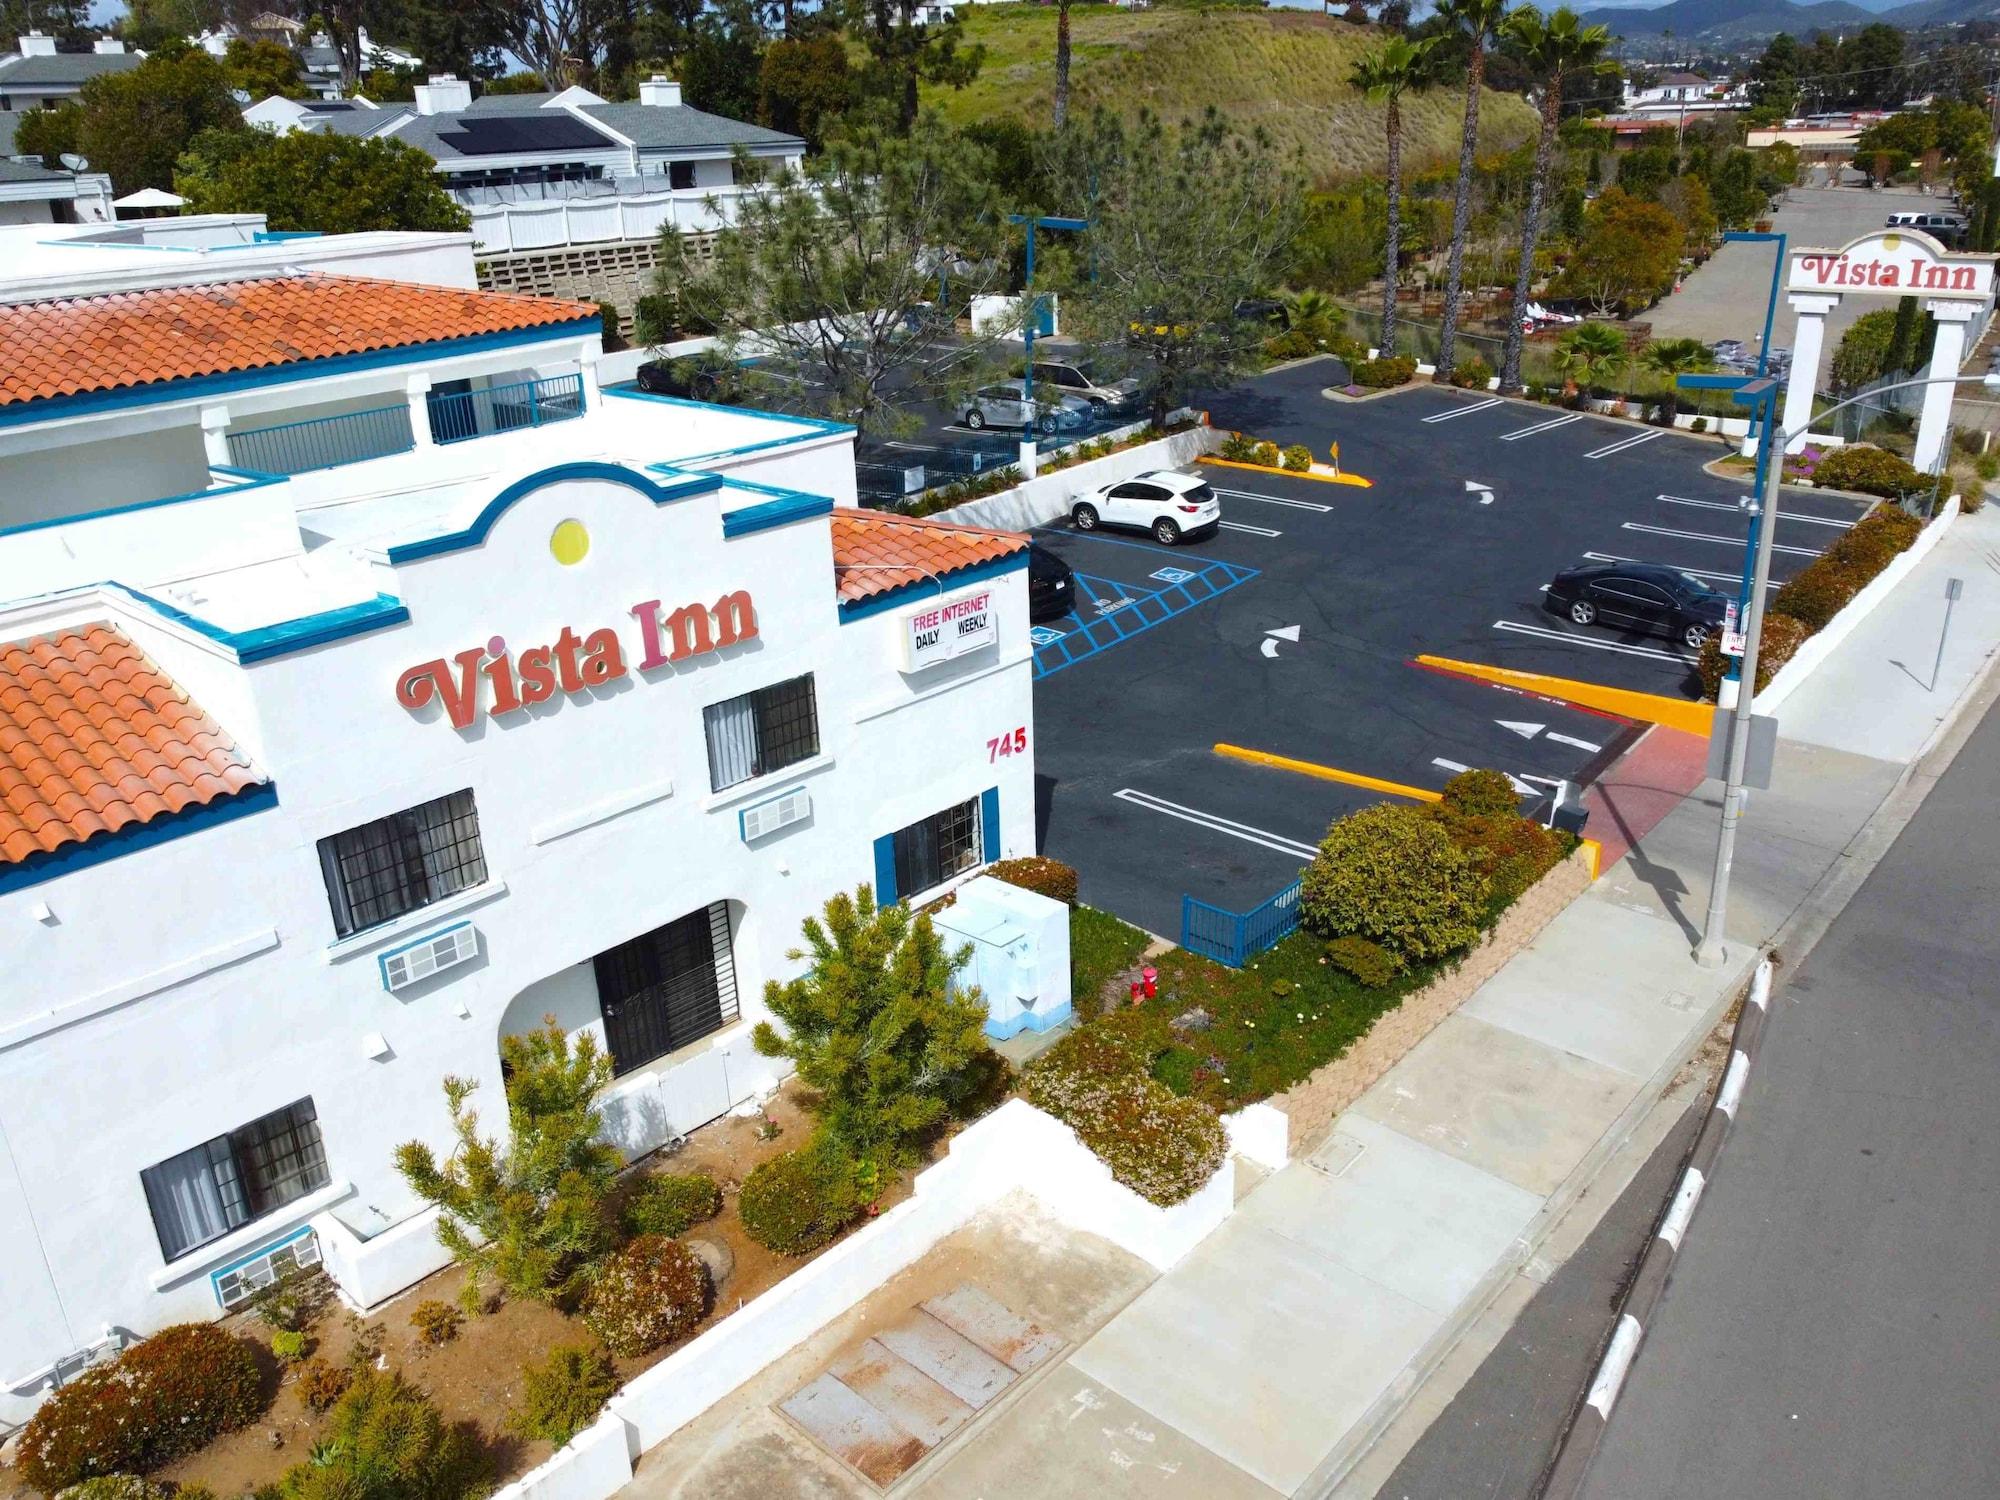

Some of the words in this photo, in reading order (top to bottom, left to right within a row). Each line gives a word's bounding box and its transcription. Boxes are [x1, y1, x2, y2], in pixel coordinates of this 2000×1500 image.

[1801, 254, 1900, 287] Vista
[1906, 259, 1977, 291] Inn
[913, 611, 939, 633] FREE
[942, 594, 990, 623] INTERNET
[916, 629, 940, 650] DAILY
[957, 612, 988, 635] WEEKLY
[395, 626, 628, 730] Vista
[631, 590, 760, 672] Inn
[986, 726, 1026, 764] 745
